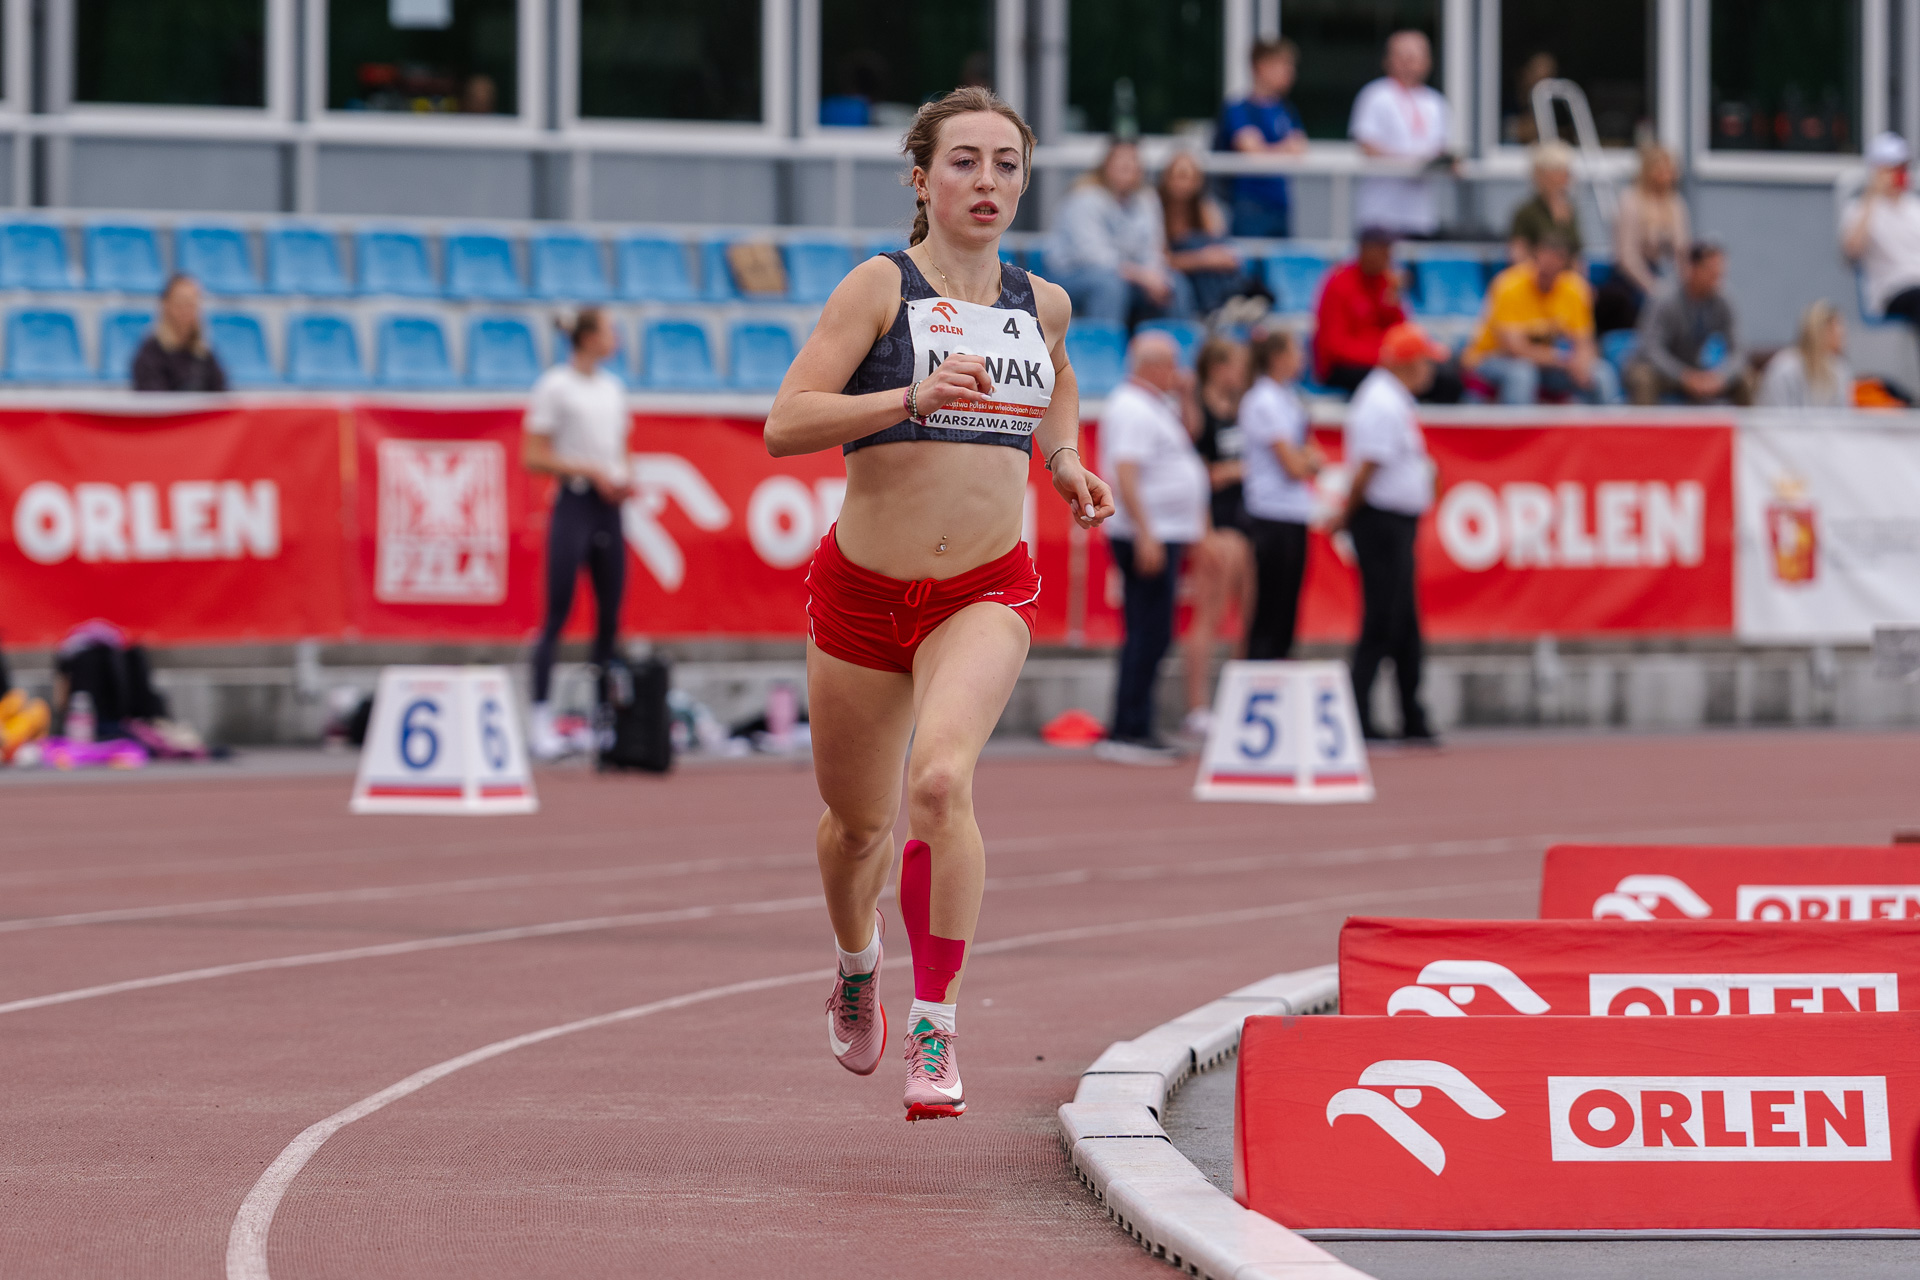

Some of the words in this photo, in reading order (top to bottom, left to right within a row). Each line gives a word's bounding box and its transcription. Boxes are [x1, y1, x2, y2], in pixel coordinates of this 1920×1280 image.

[930, 324, 963, 336] ORLEN
[1002, 317, 1020, 339] 4
[928, 349, 1044, 389] NWAK
[929, 413, 1008, 430] WARSZAWA
[1011, 420, 1033, 432] 2025
[14, 480, 280, 565] ORLEN
[1437, 480, 1704, 572] ORLEN
[399, 698, 439, 770] 6
[478, 698, 509, 771] 6
[1239, 692, 1278, 760] 5
[1317, 692, 1345, 760] 5
[1568, 1088, 1867, 1148] ORLEN
